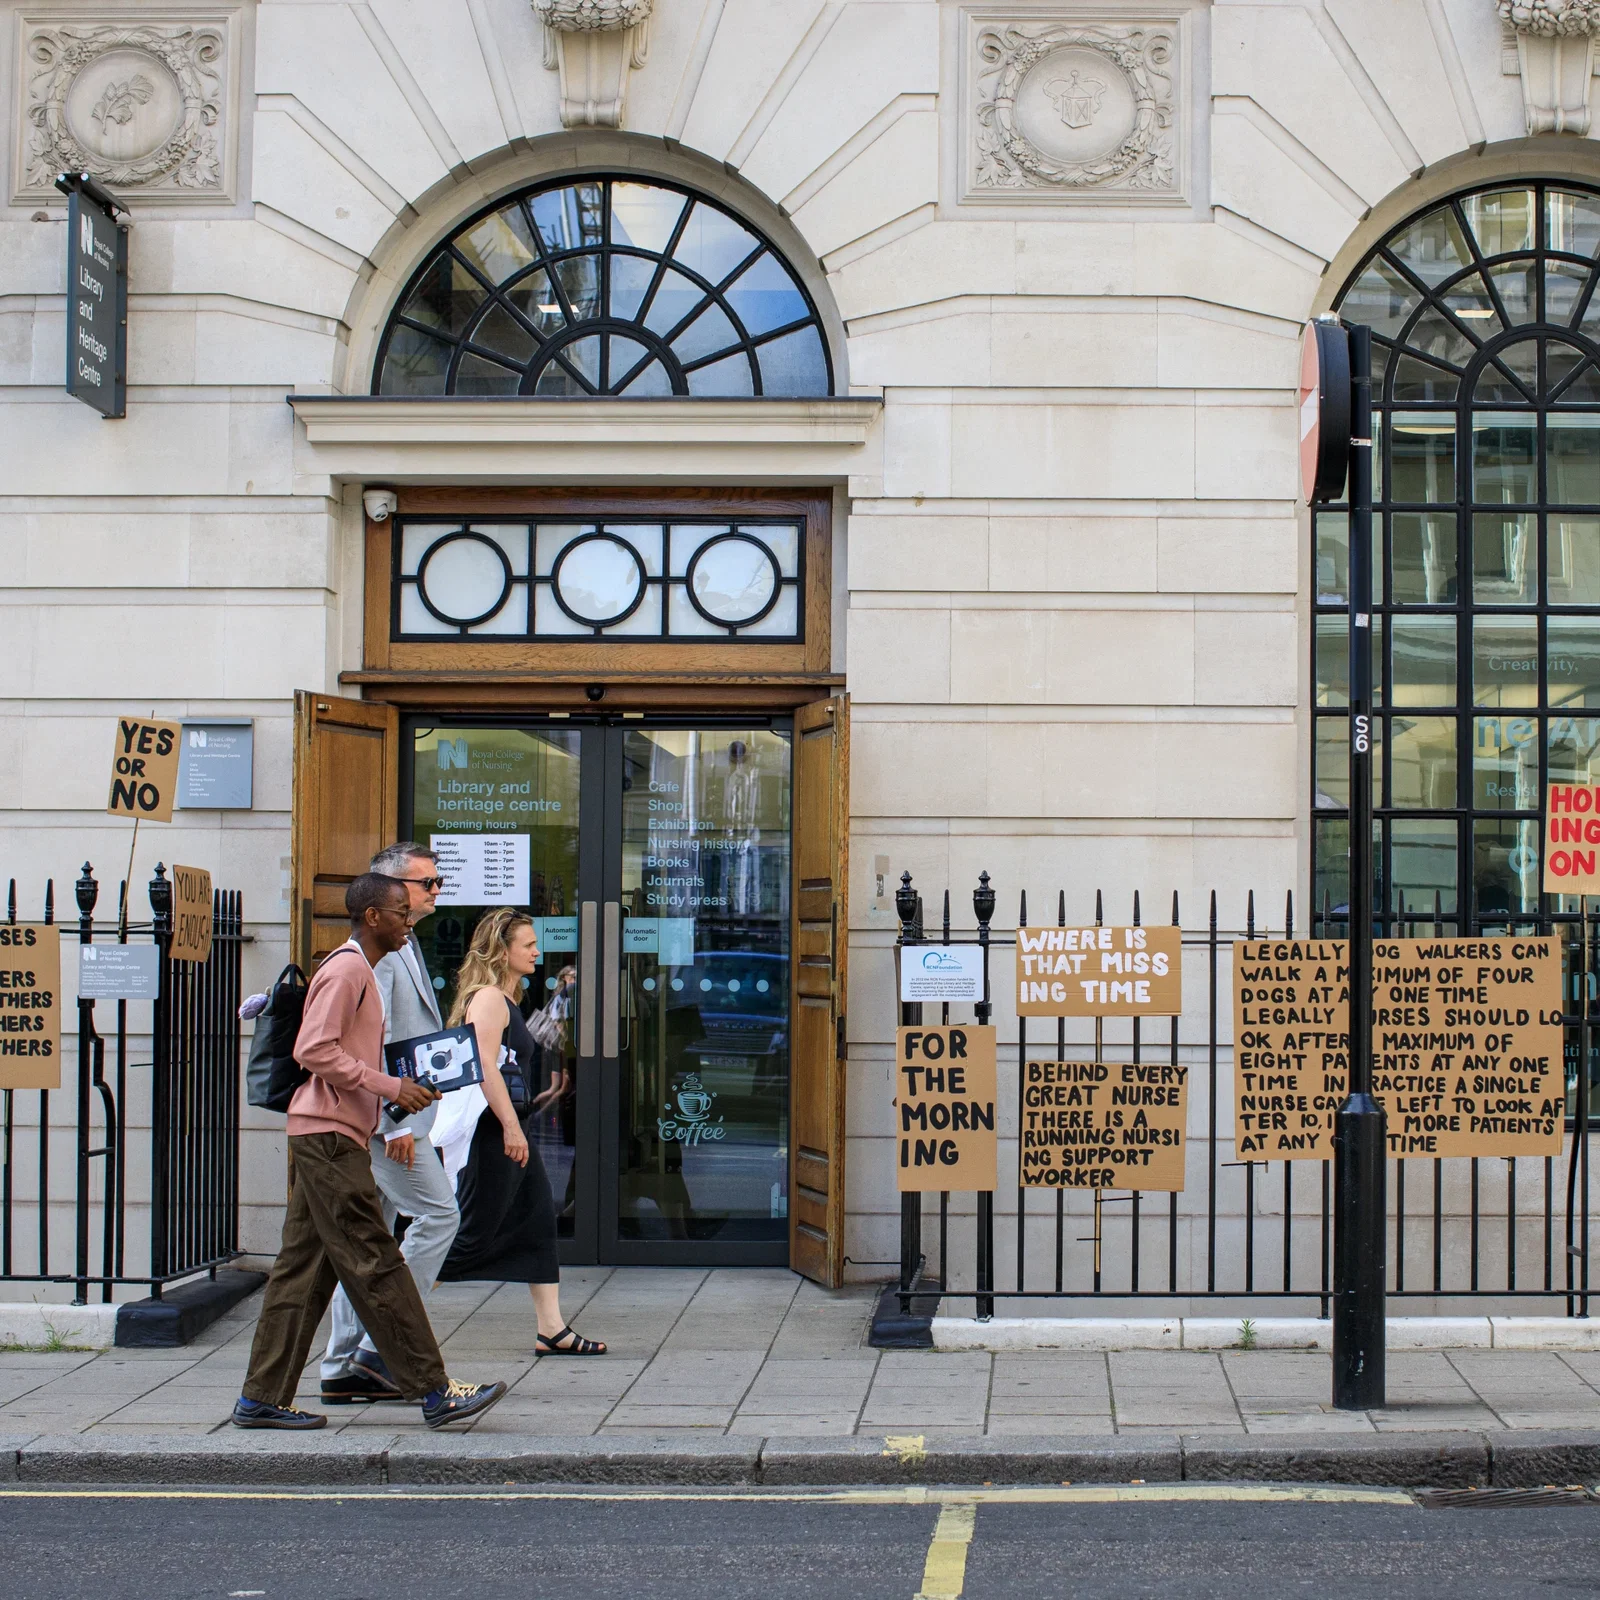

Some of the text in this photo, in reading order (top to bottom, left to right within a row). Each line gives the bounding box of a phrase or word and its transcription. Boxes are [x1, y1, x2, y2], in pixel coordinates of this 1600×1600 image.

[80, 265, 104, 302] Library
[80, 301, 93, 321] and
[79, 326, 107, 362] Heritage
[78, 357, 101, 387] Centre
[1488, 656, 1579, 676] Creatvity,
[121, 720, 175, 756] YES
[472, 750, 525, 761] Royal College
[472, 760, 513, 772] of Nursing
[116, 756, 146, 778] OR
[111, 778, 159, 811] NO
[438, 780, 531, 796] Library and
[649, 780, 680, 792] Cafe
[437, 797, 561, 814] heritage centre
[648, 800, 683, 813] Shop
[1551, 786, 1600, 814] HO
[436, 819, 517, 831] Opening hours
[648, 838, 700, 851] Nursing
[648, 856, 689, 868] Books
[1549, 850, 1596, 877] ON
[176, 872, 211, 905] YOU ARE
[647, 875, 705, 887] Journals
[647, 894, 727, 907] Study areas
[178, 914, 211, 952] ENOUGH
[1019, 928, 1147, 953] WHERE IS
[1243, 942, 1549, 962] LEGALLY OG WALKERS CAN
[1021, 952, 1169, 977] THAT MISS
[1241, 966, 1301, 983] WALK
[1314, 967, 1327, 983] A
[1437, 967, 1464, 984] OF
[1477, 967, 1535, 984] FOUR
[1020, 980, 1151, 1004] ING TIME
[1241, 987, 1297, 1004] DOGS
[1308, 987, 1334, 1004] AT
[1390, 987, 1430, 1004] ONE
[1436, 987, 1488, 1004] TIME
[1243, 1007, 1335, 1025] LEGALLY
[1445, 1008, 1530, 1027] SHOULD
[1539, 1010, 1563, 1026] LO
[905, 1030, 968, 1060] FOR
[1241, 1032, 1513, 1053] OK AFTER MAXIMUM OF
[1028, 1063, 1188, 1085] BEHIND EVERY
[1240, 1052, 1307, 1071] EIGHT
[1431, 1054, 1455, 1072] AT
[1462, 1055, 1501, 1071] ANY
[1510, 1056, 1549, 1075] ONE
[902, 1066, 966, 1097] THE
[1242, 1073, 1541, 1095] TIME IN RACTICE A SINGLE
[1026, 1085, 1180, 1107] GREAT NURSE
[1241, 1095, 1308, 1112] NURSE
[1397, 1095, 1444, 1113] LEFT
[1452, 1098, 1475, 1114] TO
[1484, 1098, 1533, 1114] LOOK
[1540, 1098, 1565, 1118] AF
[902, 1102, 995, 1132] MORN
[1027, 1109, 1148, 1129] THERE IS A
[1240, 1112, 1288, 1131] TER
[1404, 1115, 1460, 1133] MORE
[1470, 1116, 1555, 1136] PATIENTS
[1024, 1128, 1180, 1148] RUNNING NURSI
[1240, 1134, 1268, 1152] AT
[1278, 1133, 1320, 1150] ANY
[1387, 1134, 1437, 1153] TIME
[901, 1139, 959, 1168] ING
[1024, 1147, 1154, 1167] NG SUPPORT
[1023, 1168, 1115, 1187] WORKER
